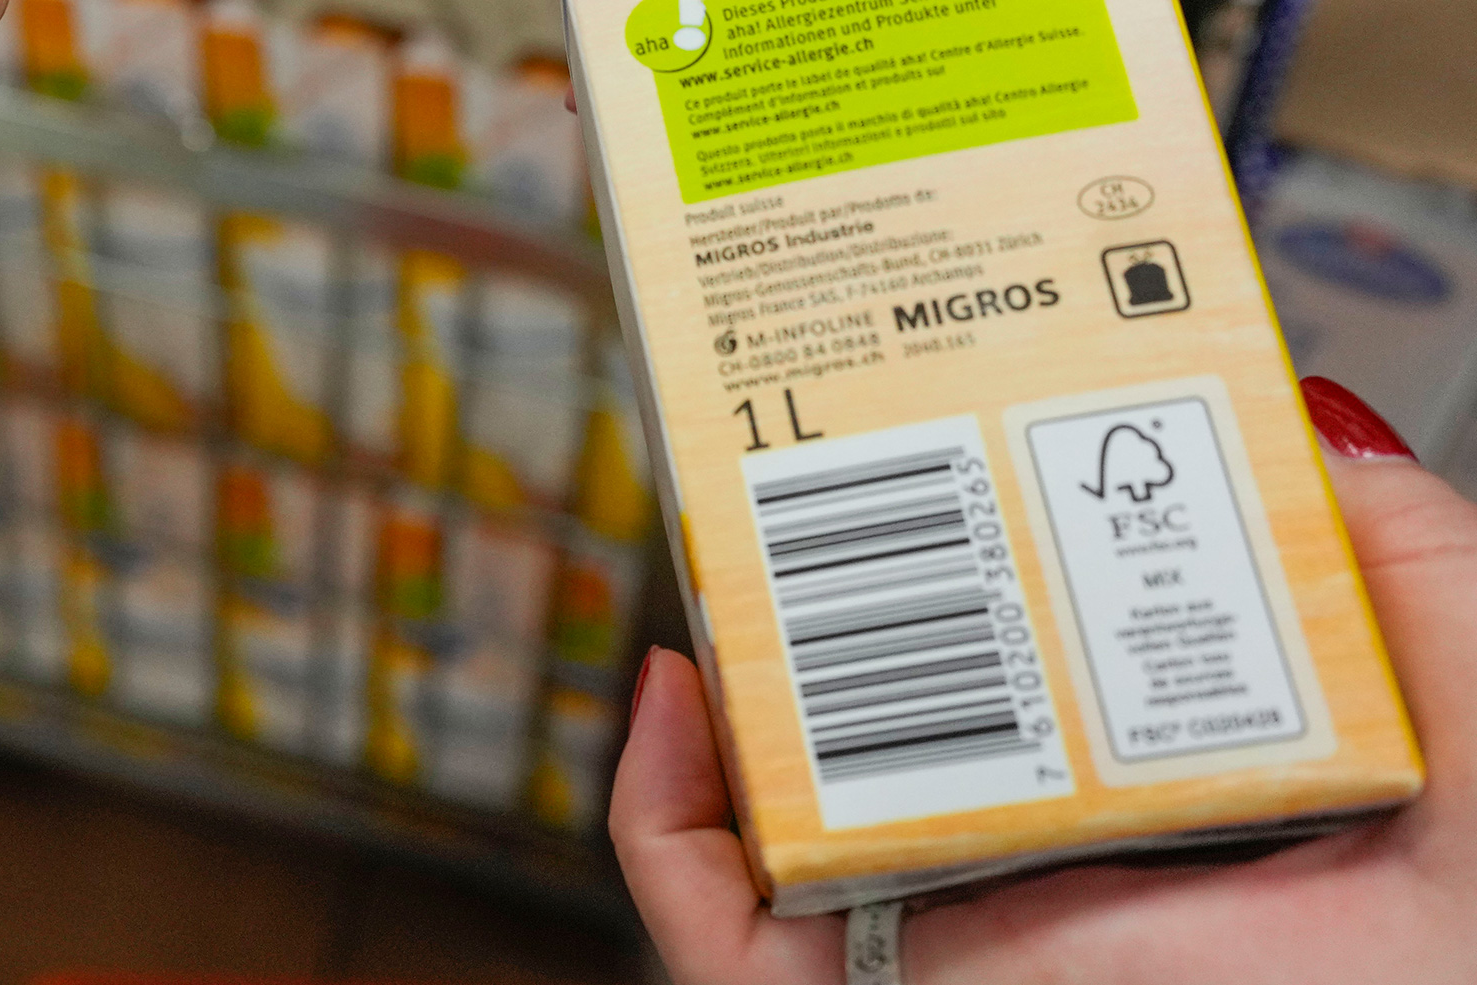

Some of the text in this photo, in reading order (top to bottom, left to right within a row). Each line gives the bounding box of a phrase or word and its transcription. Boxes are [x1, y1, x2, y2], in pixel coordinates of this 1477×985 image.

[721, 0, 776, 22] Dieses
[721, 25, 837, 60] Informationen
[839, 16, 872, 36] und
[874, 3, 950, 28] Produkte
[726, 20, 761, 41] aha!
[678, 36, 874, 89] www.service-allergie.ch
[694, 236, 780, 267] MIGROS
[891, 277, 1060, 332] MIGROS
[733, 387, 824, 452] 1 L
